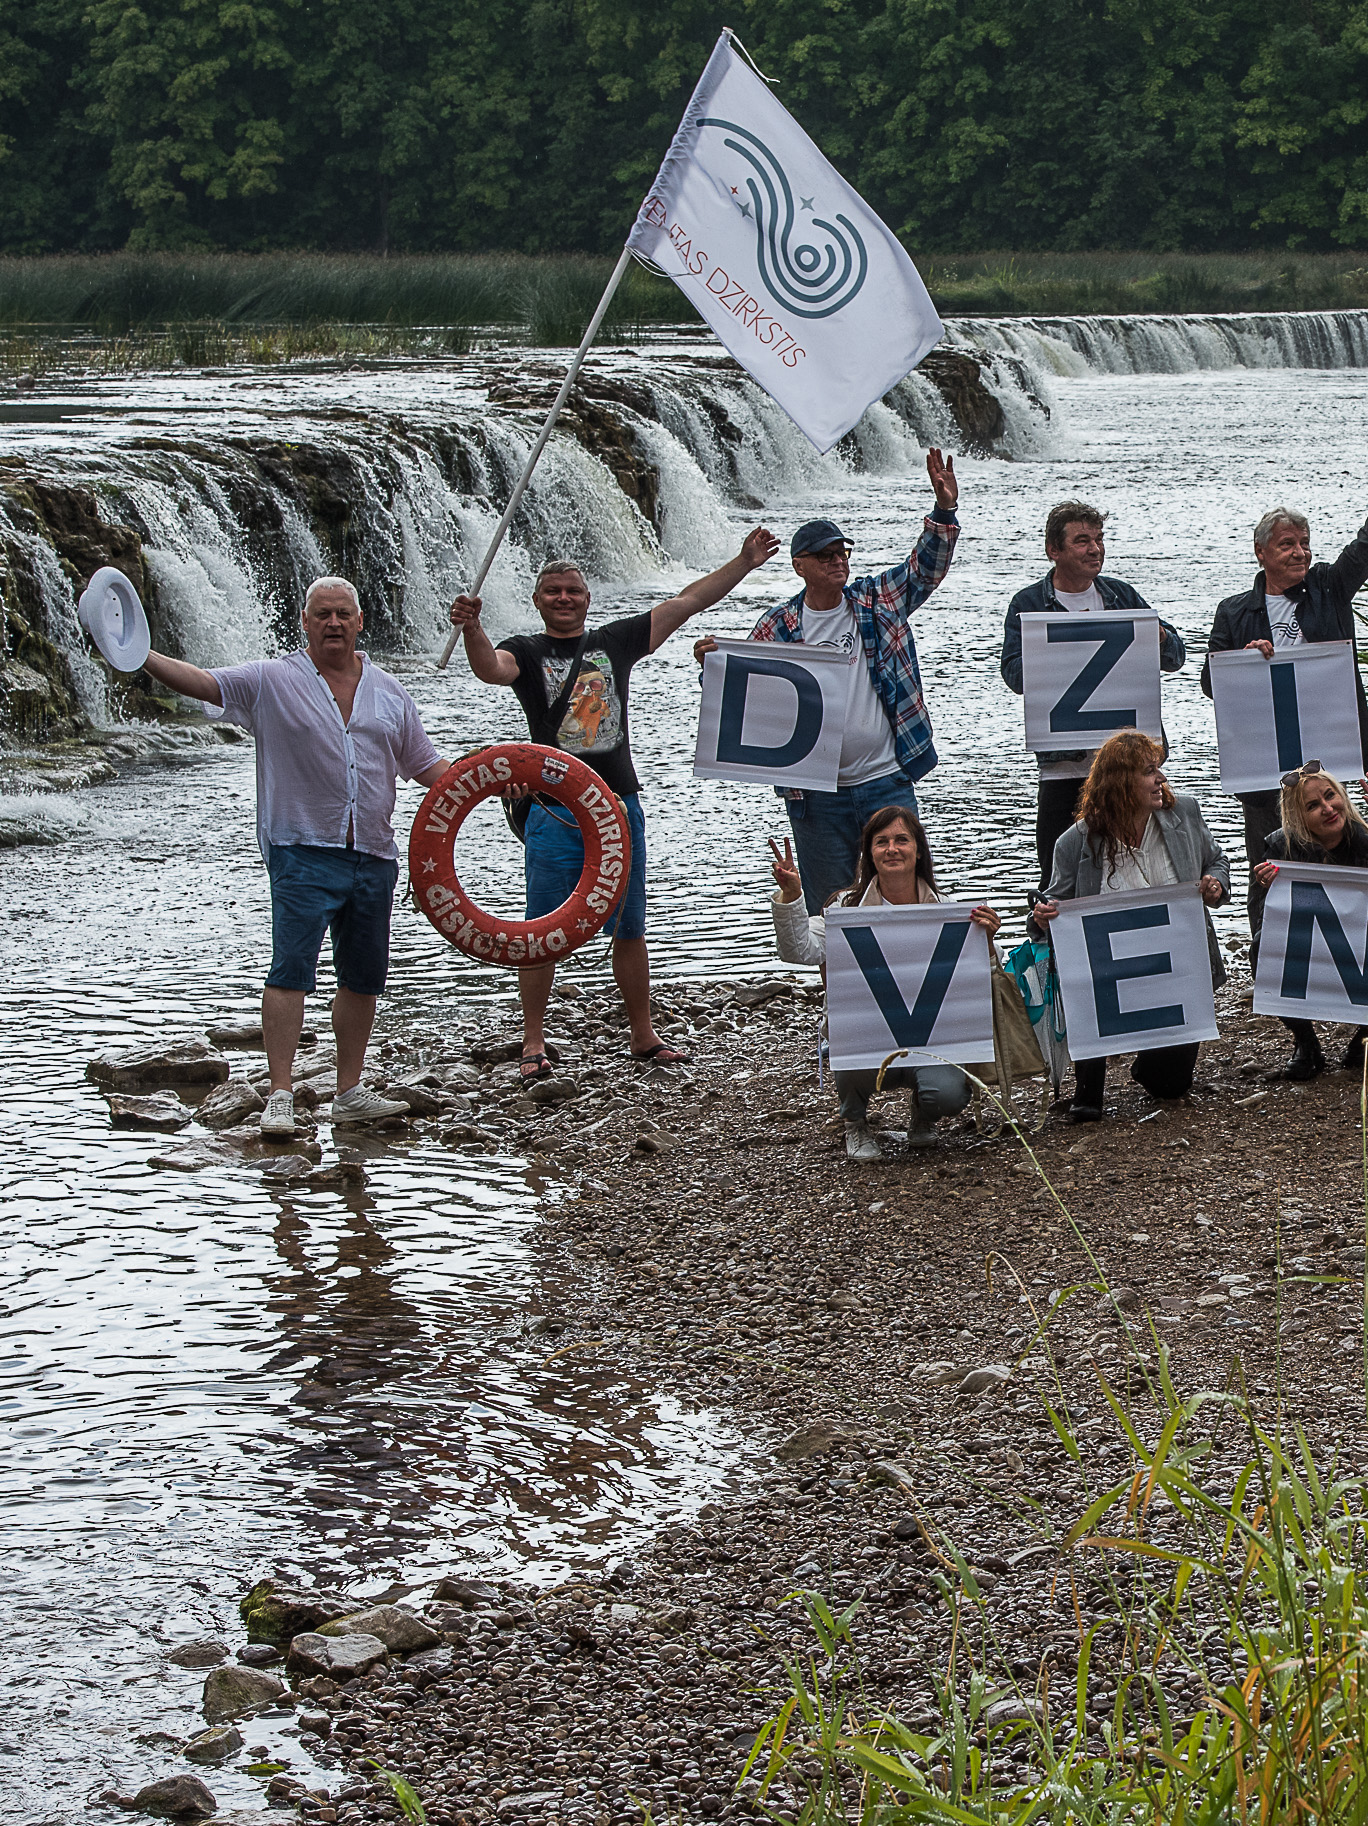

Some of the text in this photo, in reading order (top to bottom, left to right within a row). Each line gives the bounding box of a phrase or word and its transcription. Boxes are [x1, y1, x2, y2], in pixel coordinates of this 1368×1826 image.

[705, 267, 807, 368] DZIRKSTIS
[716, 654, 824, 768] D
[1047, 620, 1137, 732] Z
[1269, 662, 1304, 773] I
[425, 883, 569, 961] diskotēka
[1082, 904, 1186, 1038] E
[842, 922, 970, 1047] V
